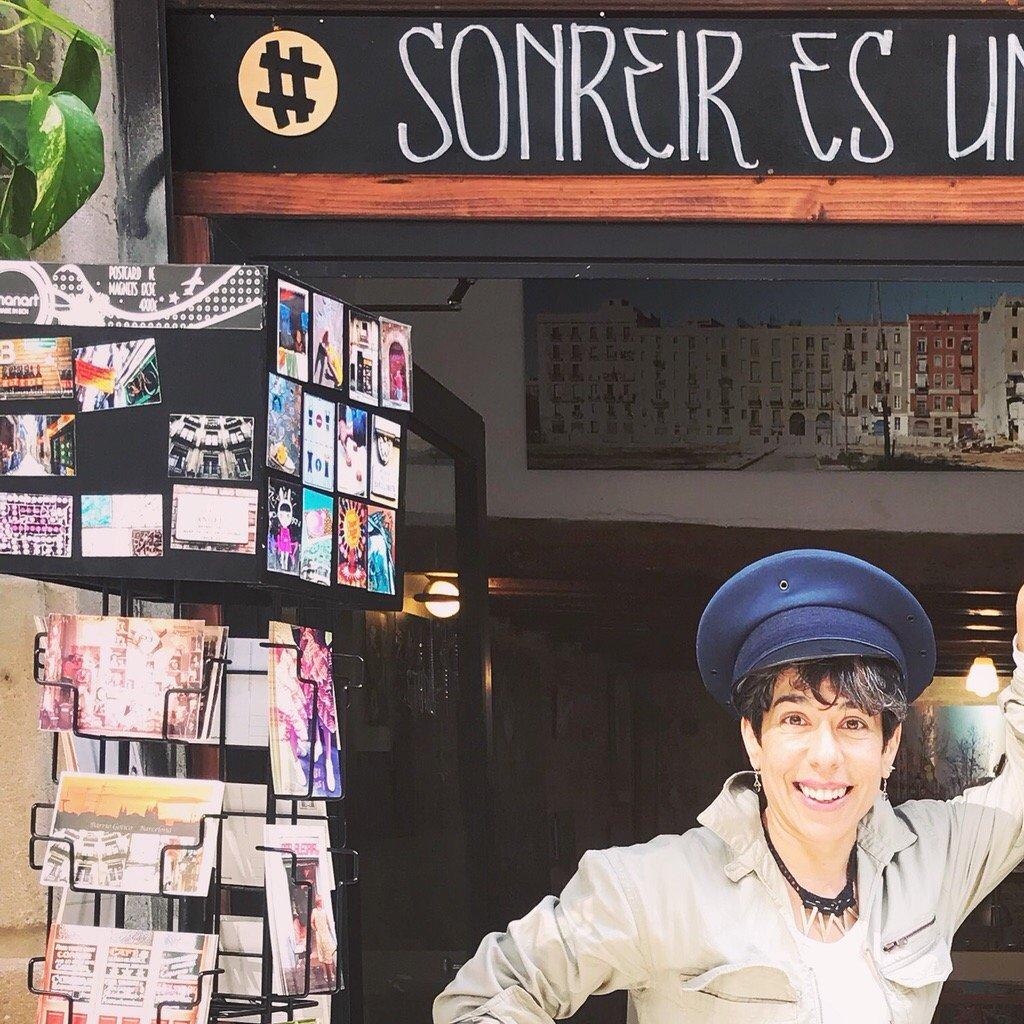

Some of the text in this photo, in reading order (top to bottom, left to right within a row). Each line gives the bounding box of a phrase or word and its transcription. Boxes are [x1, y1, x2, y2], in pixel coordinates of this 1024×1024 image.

[398, 22, 759, 169] SONREIR
[790, 29, 895, 163] ES
[108, 265, 142, 280] POSTCARD
